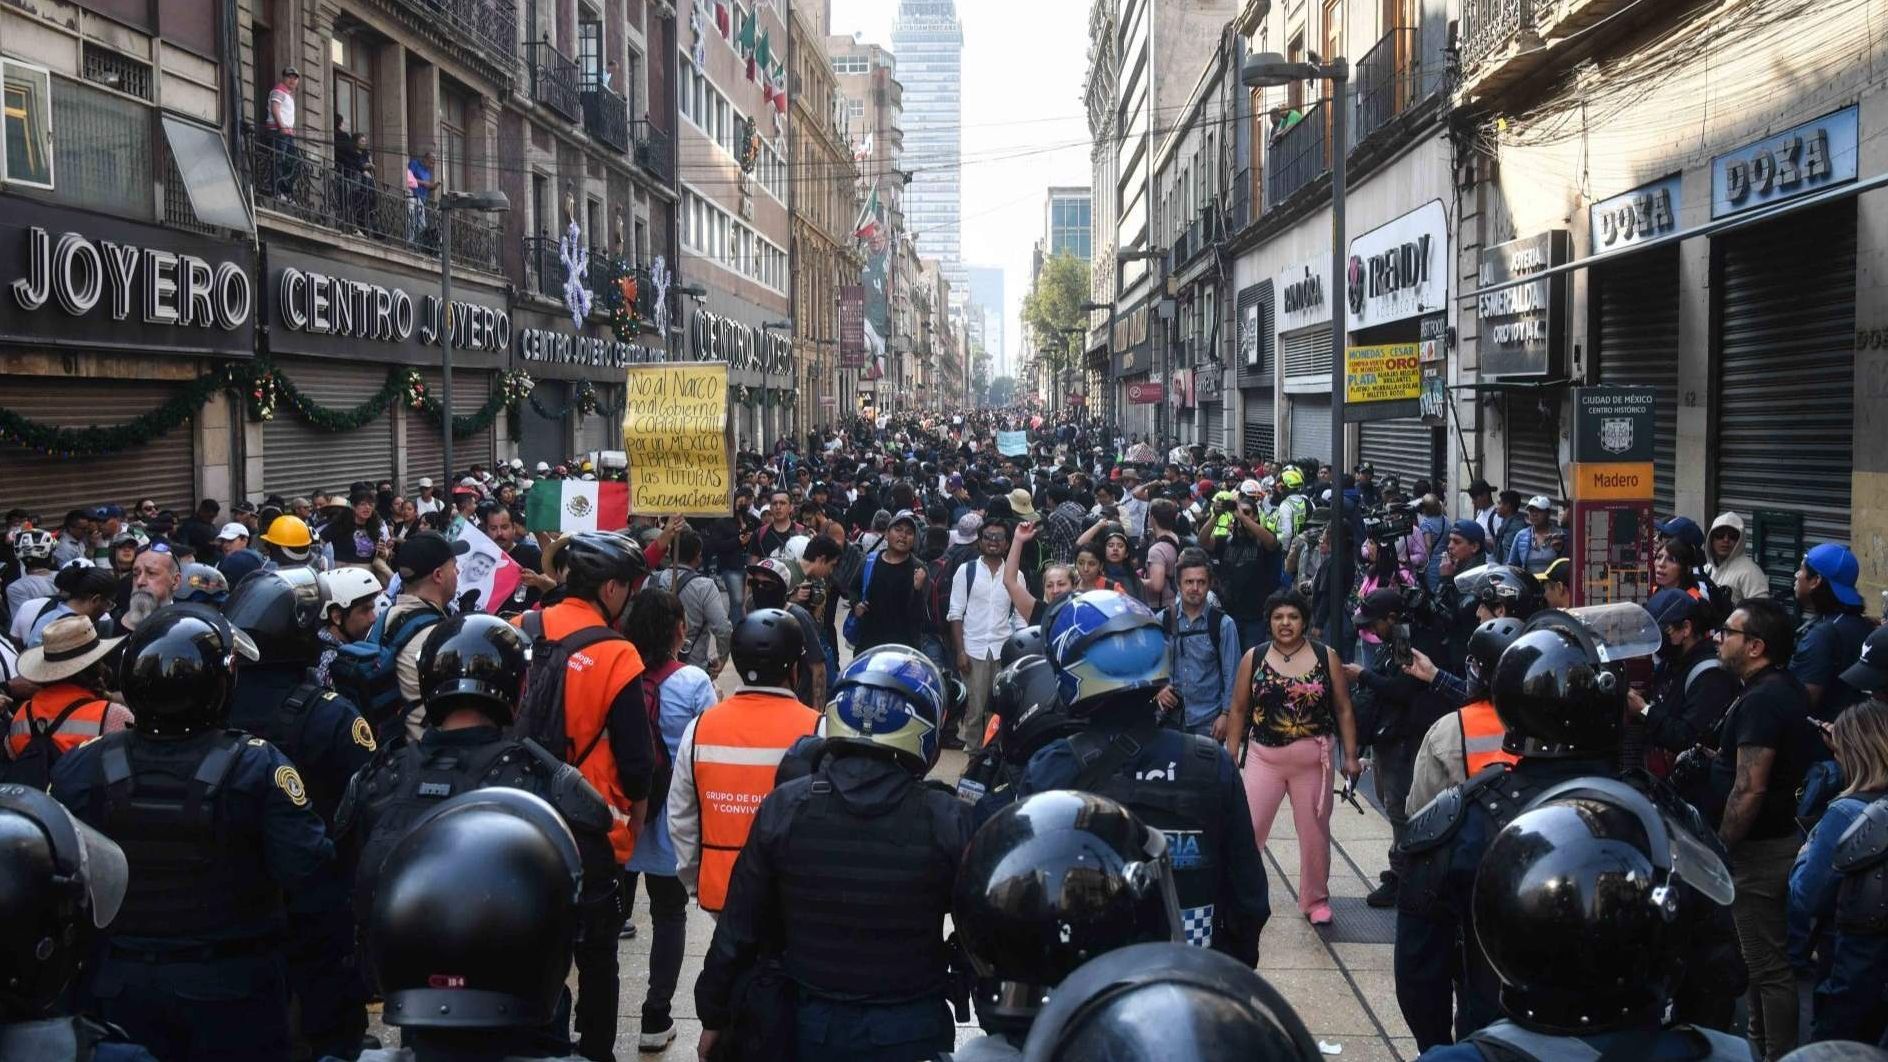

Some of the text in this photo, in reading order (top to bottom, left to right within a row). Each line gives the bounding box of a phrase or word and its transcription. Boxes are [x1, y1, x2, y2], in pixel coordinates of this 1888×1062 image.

[1367, 234, 1430, 298] TRENDY
[1479, 263, 1491, 286] LA
[10, 226, 251, 330] JOYERO
[280, 266, 413, 341] CENTRO
[1478, 283, 1540, 318] ESMERALDA
[694, 309, 752, 370] CENTRO
[1493, 324, 1508, 343] ORO
[521, 328, 571, 363] CENTRO
[574, 335, 612, 367] JOYERO
[1386, 357, 1418, 370] ORO
[631, 369, 718, 400] No al Narco
[1348, 374, 1377, 386] PLATA
[660, 398, 718, 417] Gobierno
[1582, 394, 1652, 404] CIUDAD DE MÉXICO
[1588, 405, 1646, 414] CENTRO HISTÓRICO
[641, 468, 659, 484] las
[1593, 473, 1638, 488] Madero
[705, 790, 734, 801] GRUPO
[736, 794, 749, 802] DE
[712, 802, 759, 814] Y CONVIV
